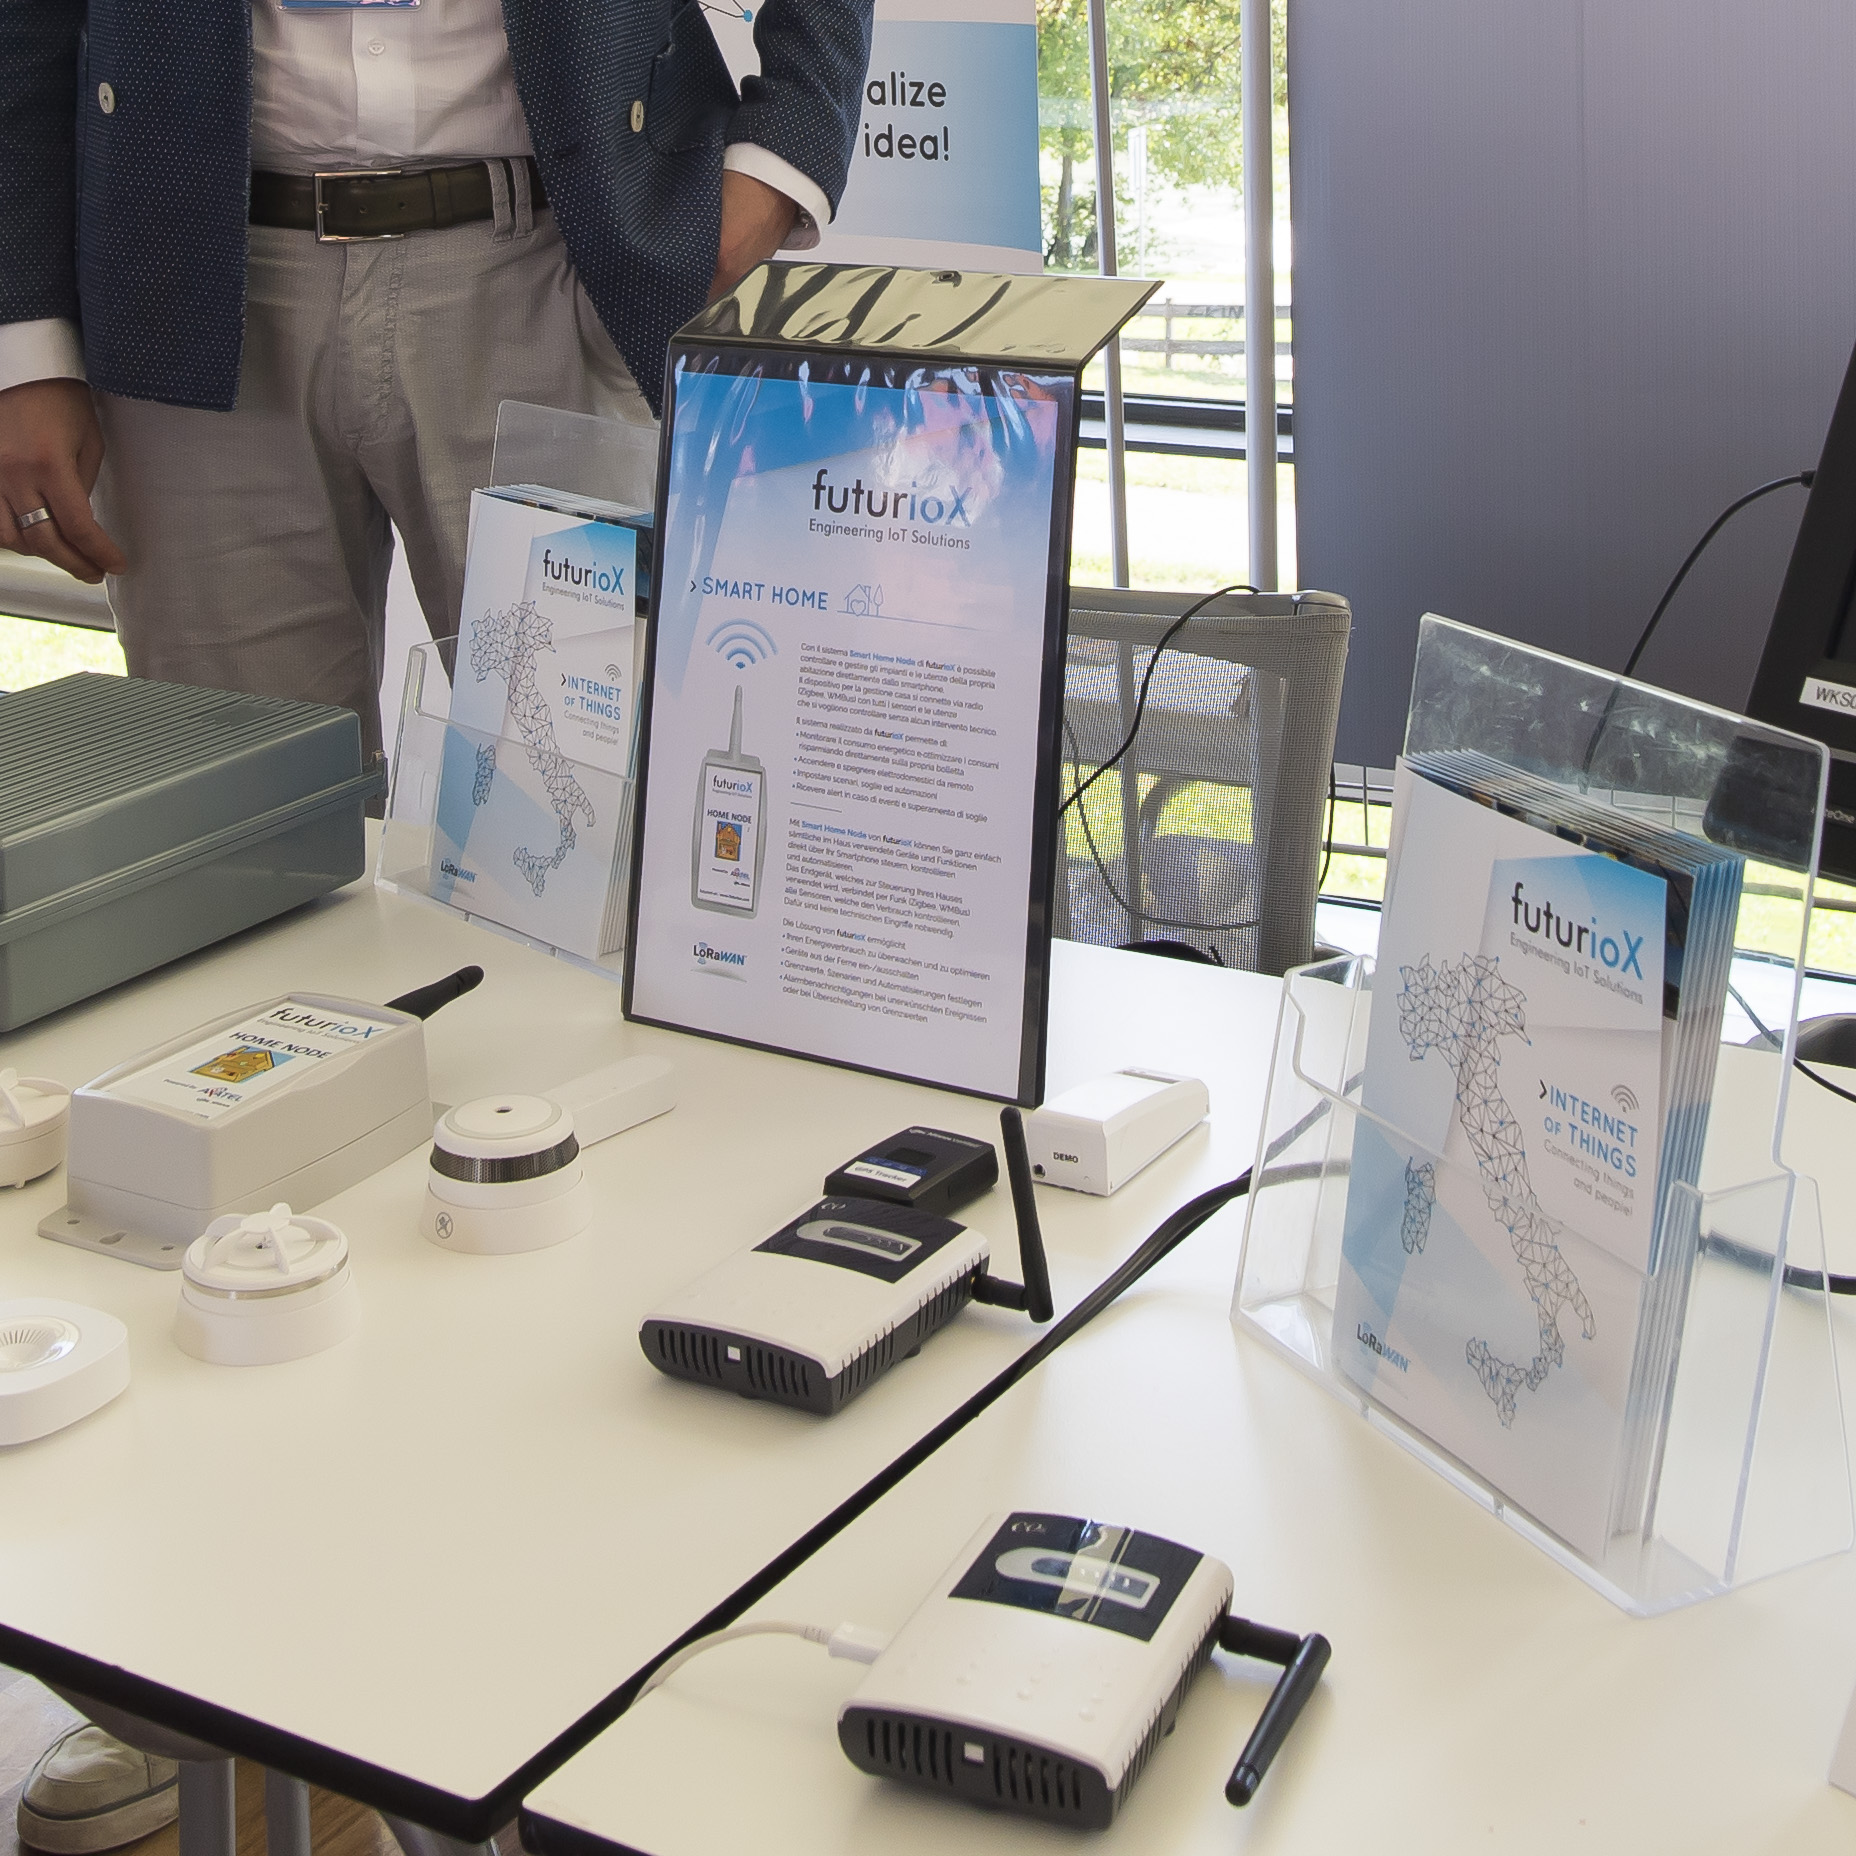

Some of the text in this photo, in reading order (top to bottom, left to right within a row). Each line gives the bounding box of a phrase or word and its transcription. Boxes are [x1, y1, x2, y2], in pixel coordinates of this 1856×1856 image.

[866, 70, 948, 109] alize
[863, 122, 951, 163] idea!
[812, 469, 973, 528] futurioX
[809, 517, 971, 551] Engineering IoT Solutions
[542, 549, 625, 596] futurioX
[542, 582, 581, 603] Engineering
[594, 594, 625, 612] Solutions
[701, 576, 829, 612] SMART HOME
[849, 649, 871, 660] Smart
[872, 653, 894, 663] Home
[895, 656, 915, 666] Node
[963, 666, 995, 679] possibile
[568, 675, 622, 702] INTERNET
[564, 695, 621, 721] OF THINGS
[712, 774, 753, 793] futurioX
[707, 808, 752, 825] HOME NODE
[801, 820, 822, 830] Smart
[824, 824, 846, 834] Home
[847, 828, 867, 838] Node
[868, 833, 881, 841] von
[954, 848, 972, 859] ganz
[973, 851, 1001, 863] einfach
[1511, 881, 1644, 981] futurioX
[1510, 931, 1643, 1005] Engineering IoT Solutions
[269, 1007, 385, 1040] futurioX
[229, 1031, 333, 1060] HOME NODE
[1549, 1084, 1639, 1148] INTERNET
[1053, 1151, 1080, 1164] DEMO
[1544, 1116, 1637, 1178] OF THINGS
[1544, 1138, 1634, 1200] Connecting things
[1574, 1177, 1593, 1196] and
